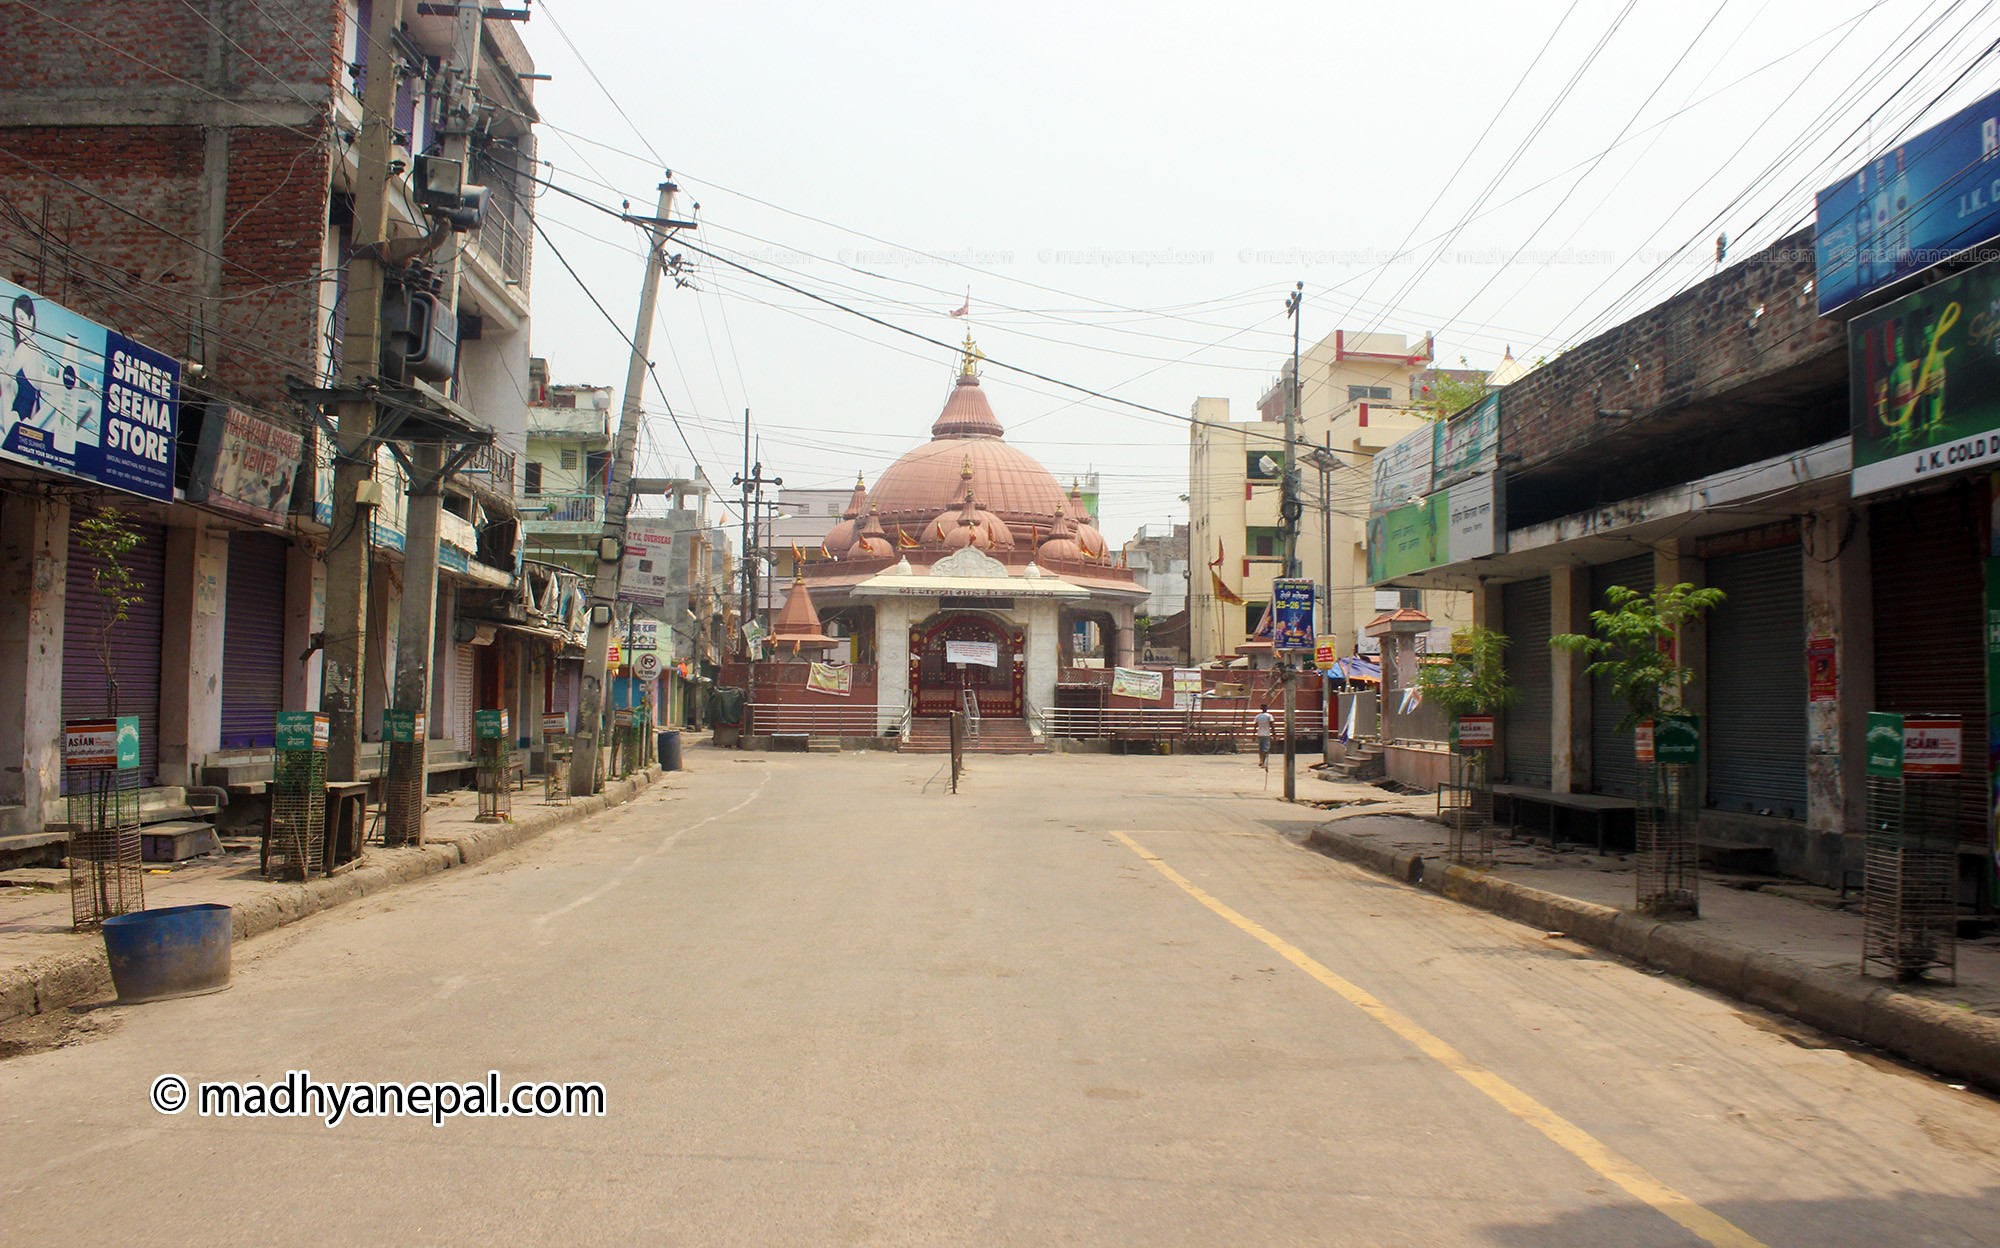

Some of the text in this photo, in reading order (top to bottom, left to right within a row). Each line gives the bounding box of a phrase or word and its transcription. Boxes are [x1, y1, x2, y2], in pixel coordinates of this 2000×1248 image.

[112, 350, 172, 399] SHREE
[107, 383, 172, 433] SEEMA
[107, 418, 168, 464] STORE
[1946, 438, 1986, 465] COLD
[243, 444, 278, 479] CENTER
[643, 533, 672, 545] OVERSEAS
[68, 735, 95, 747] ASIAN
